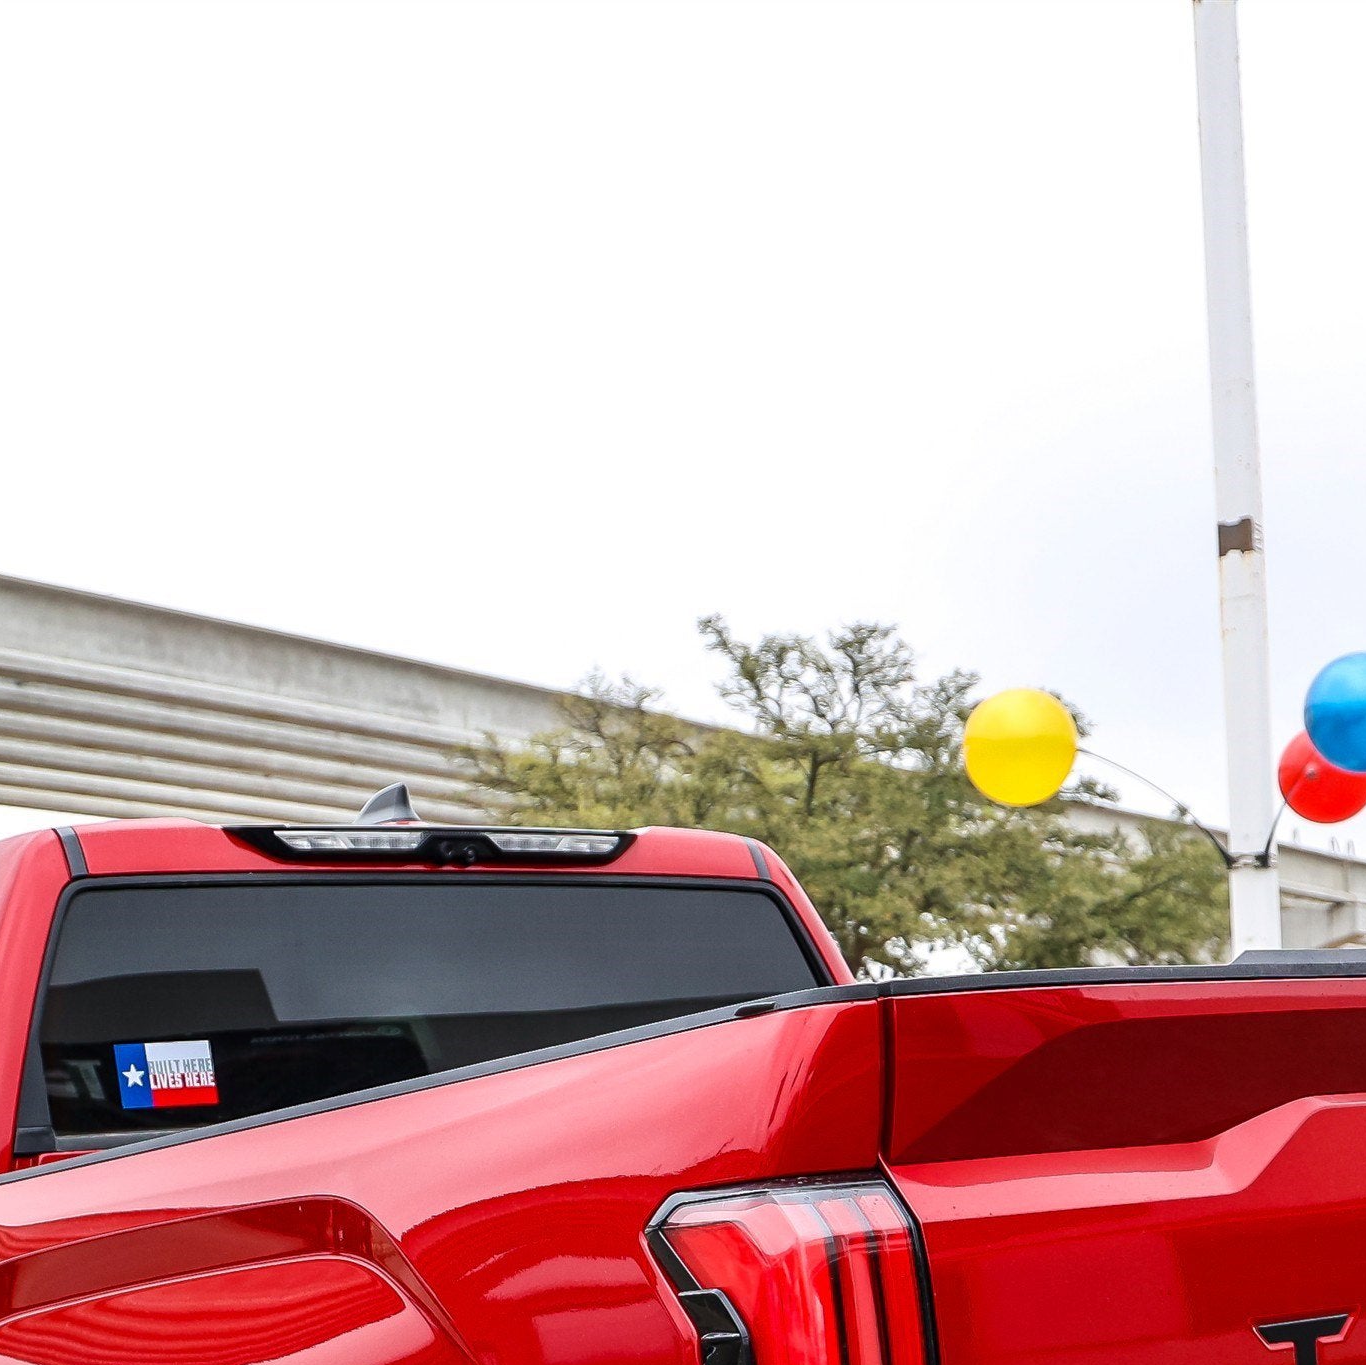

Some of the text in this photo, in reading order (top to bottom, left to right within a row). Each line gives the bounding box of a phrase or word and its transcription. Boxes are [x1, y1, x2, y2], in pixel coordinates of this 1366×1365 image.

[148, 1057, 213, 1075] BUILT HERE
[149, 1072, 216, 1090] LIVES HERE
